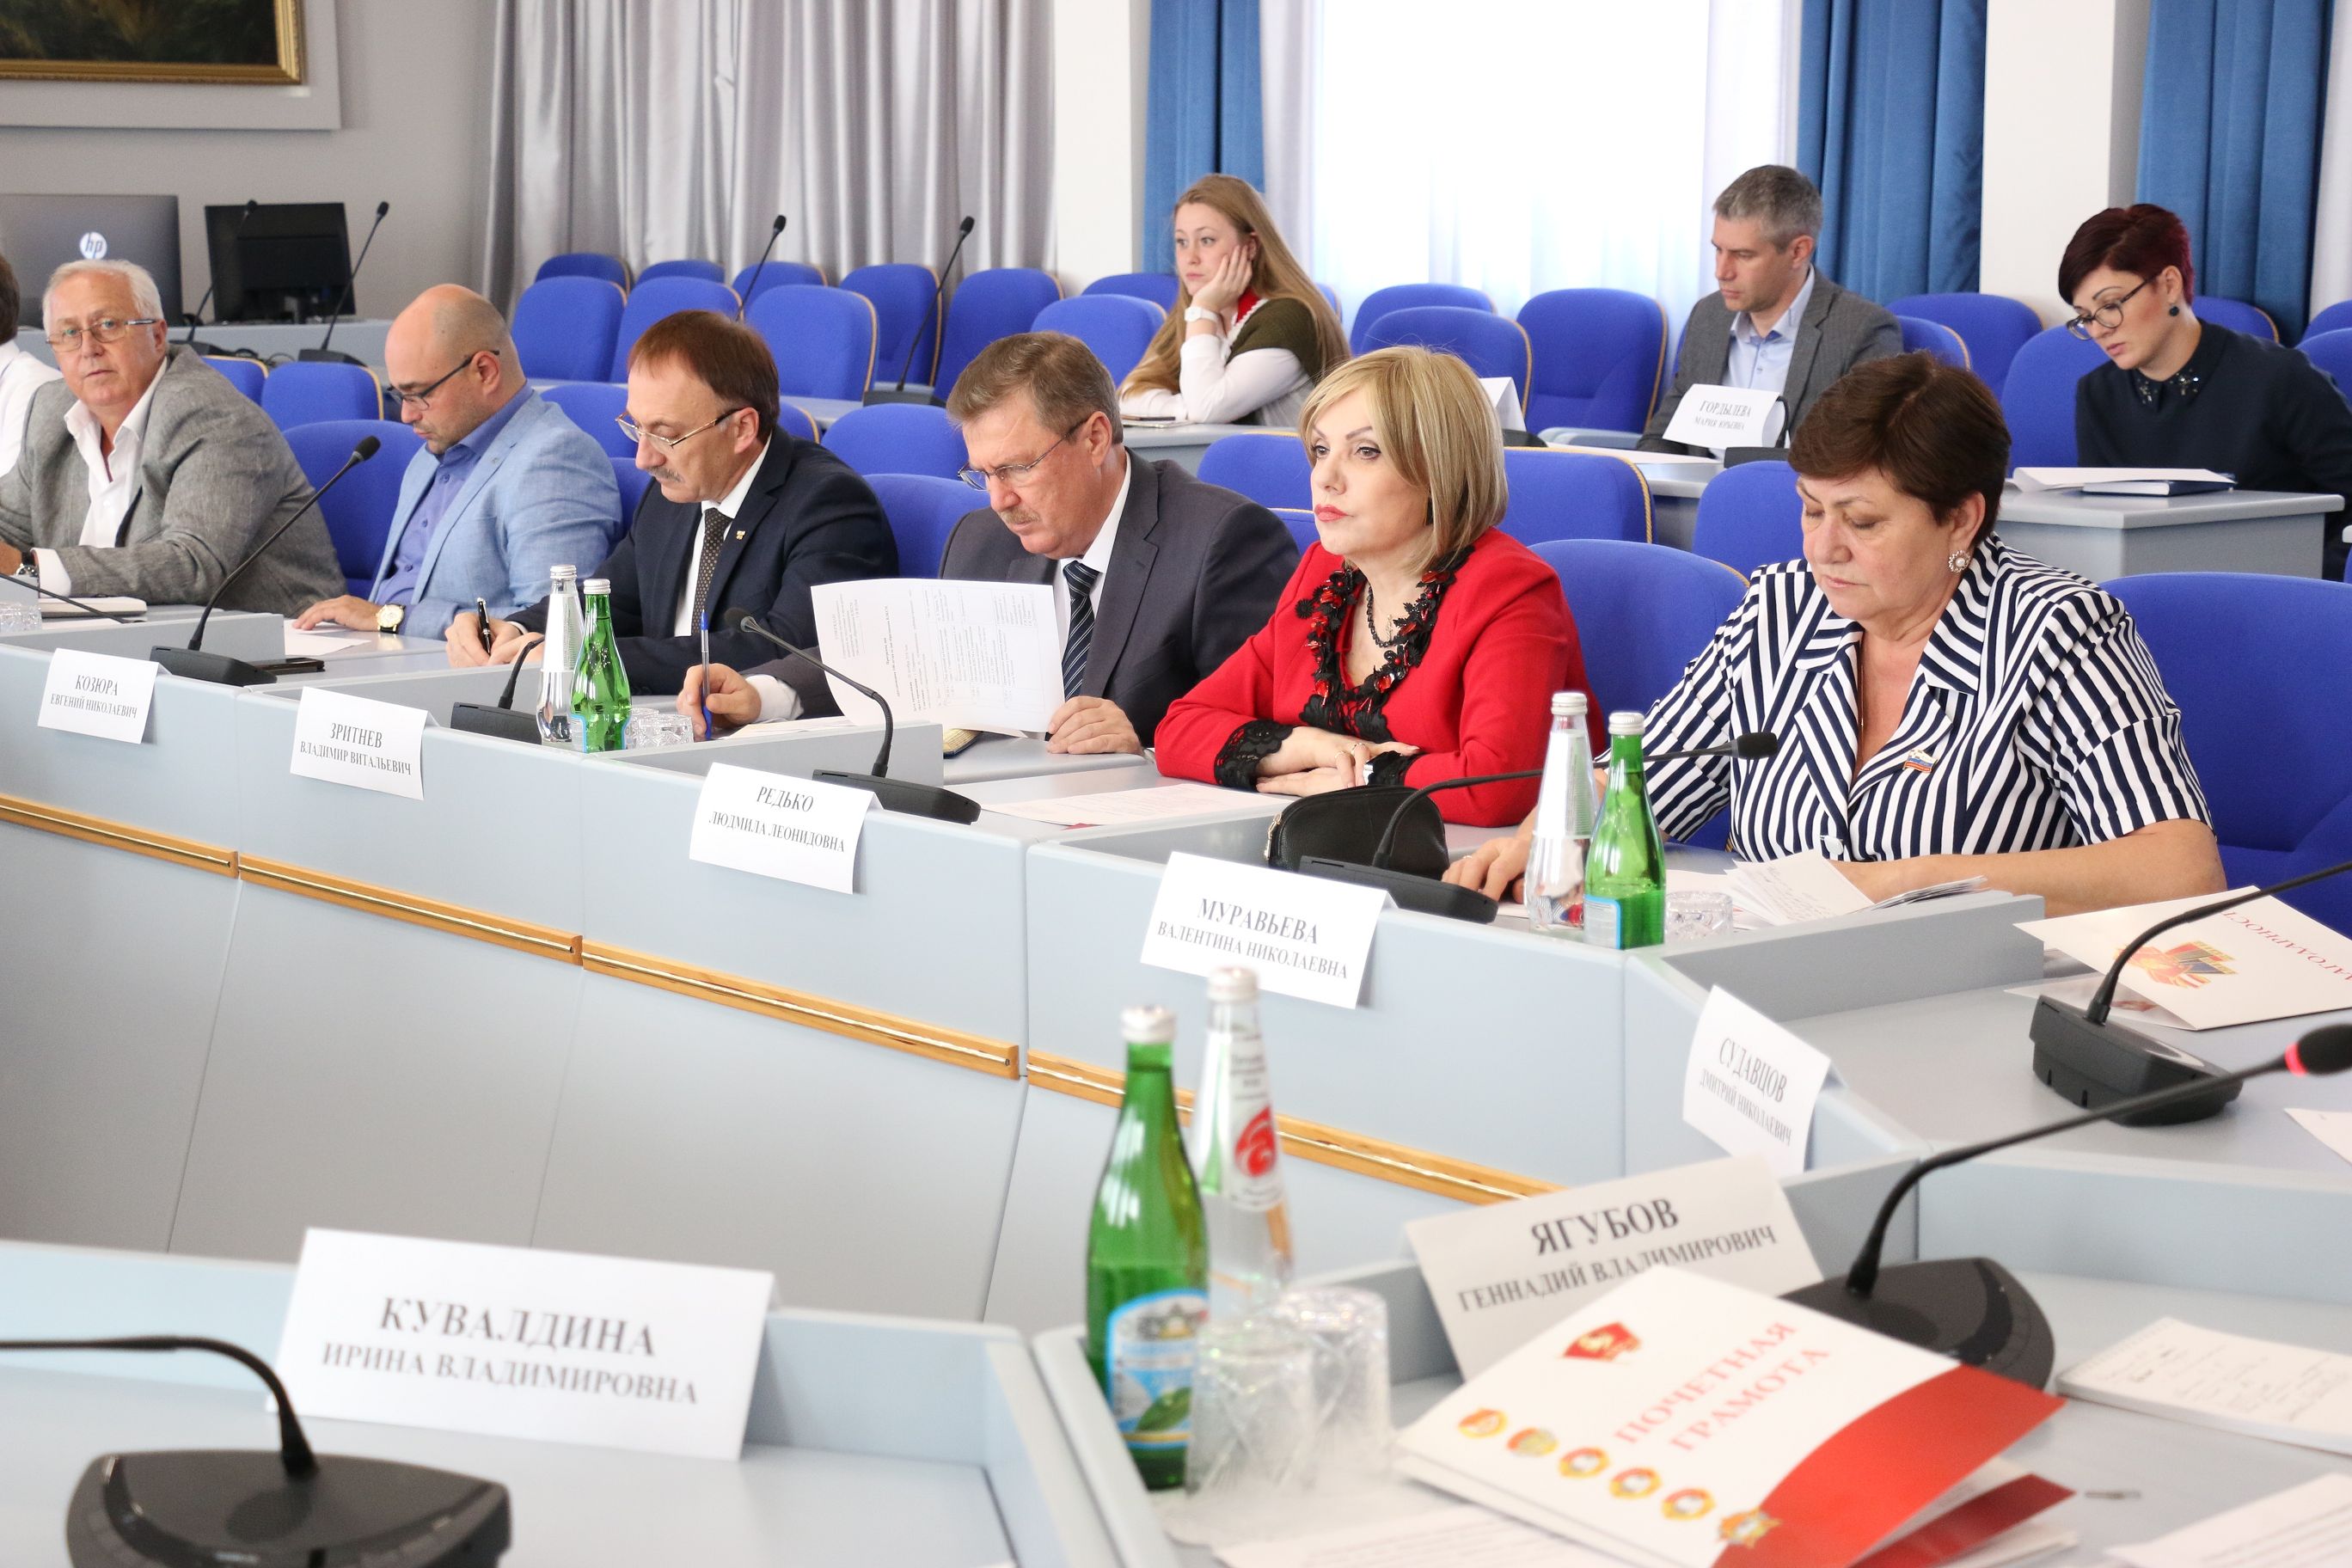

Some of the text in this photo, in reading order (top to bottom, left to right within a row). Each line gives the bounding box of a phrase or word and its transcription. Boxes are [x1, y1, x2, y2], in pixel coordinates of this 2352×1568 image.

[85, 232, 104, 259] hp
[51, 694, 138, 719] ЕВГЕНИЙ НИКОЛАЕВИЧ
[76, 675, 118, 695] КОЗЮРА
[300, 741, 412, 775] ВЛАДИМИР ВИТАЛЬЕВИЧ
[330, 722, 383, 749] ЗРИТНЕВ
[756, 786, 814, 812] РЕДЬКО
[708, 811, 845, 853] ЛЮДМИЛА ЛЕОНИДОВНА
[1157, 921, 1348, 980] ВАЛЕНТИНА НИКОЛАЕВНА
[1197, 897, 1318, 945] МУРАВЬЕВА
[1718, 1038, 1788, 1104] СУДАВЦОВ
[1700, 1069, 1793, 1148] ДМИТРИЙ НИКОЛАЕВИЧ
[1530, 1197, 1680, 1256] ЯГУБОВ
[1457, 1225, 1778, 1312] ГЕННАДИЙ ВЛАДИМИРОВИЧ
[378, 1295, 656, 1357] КУВАЛДИНА
[322, 1341, 698, 1405] ИРИНА ВЛАДИМИРОВНА
[1615, 1322, 1795, 1443] ПОЧЕТНАЯ
[1673, 1349, 1828, 1451] ГРАМОТА
